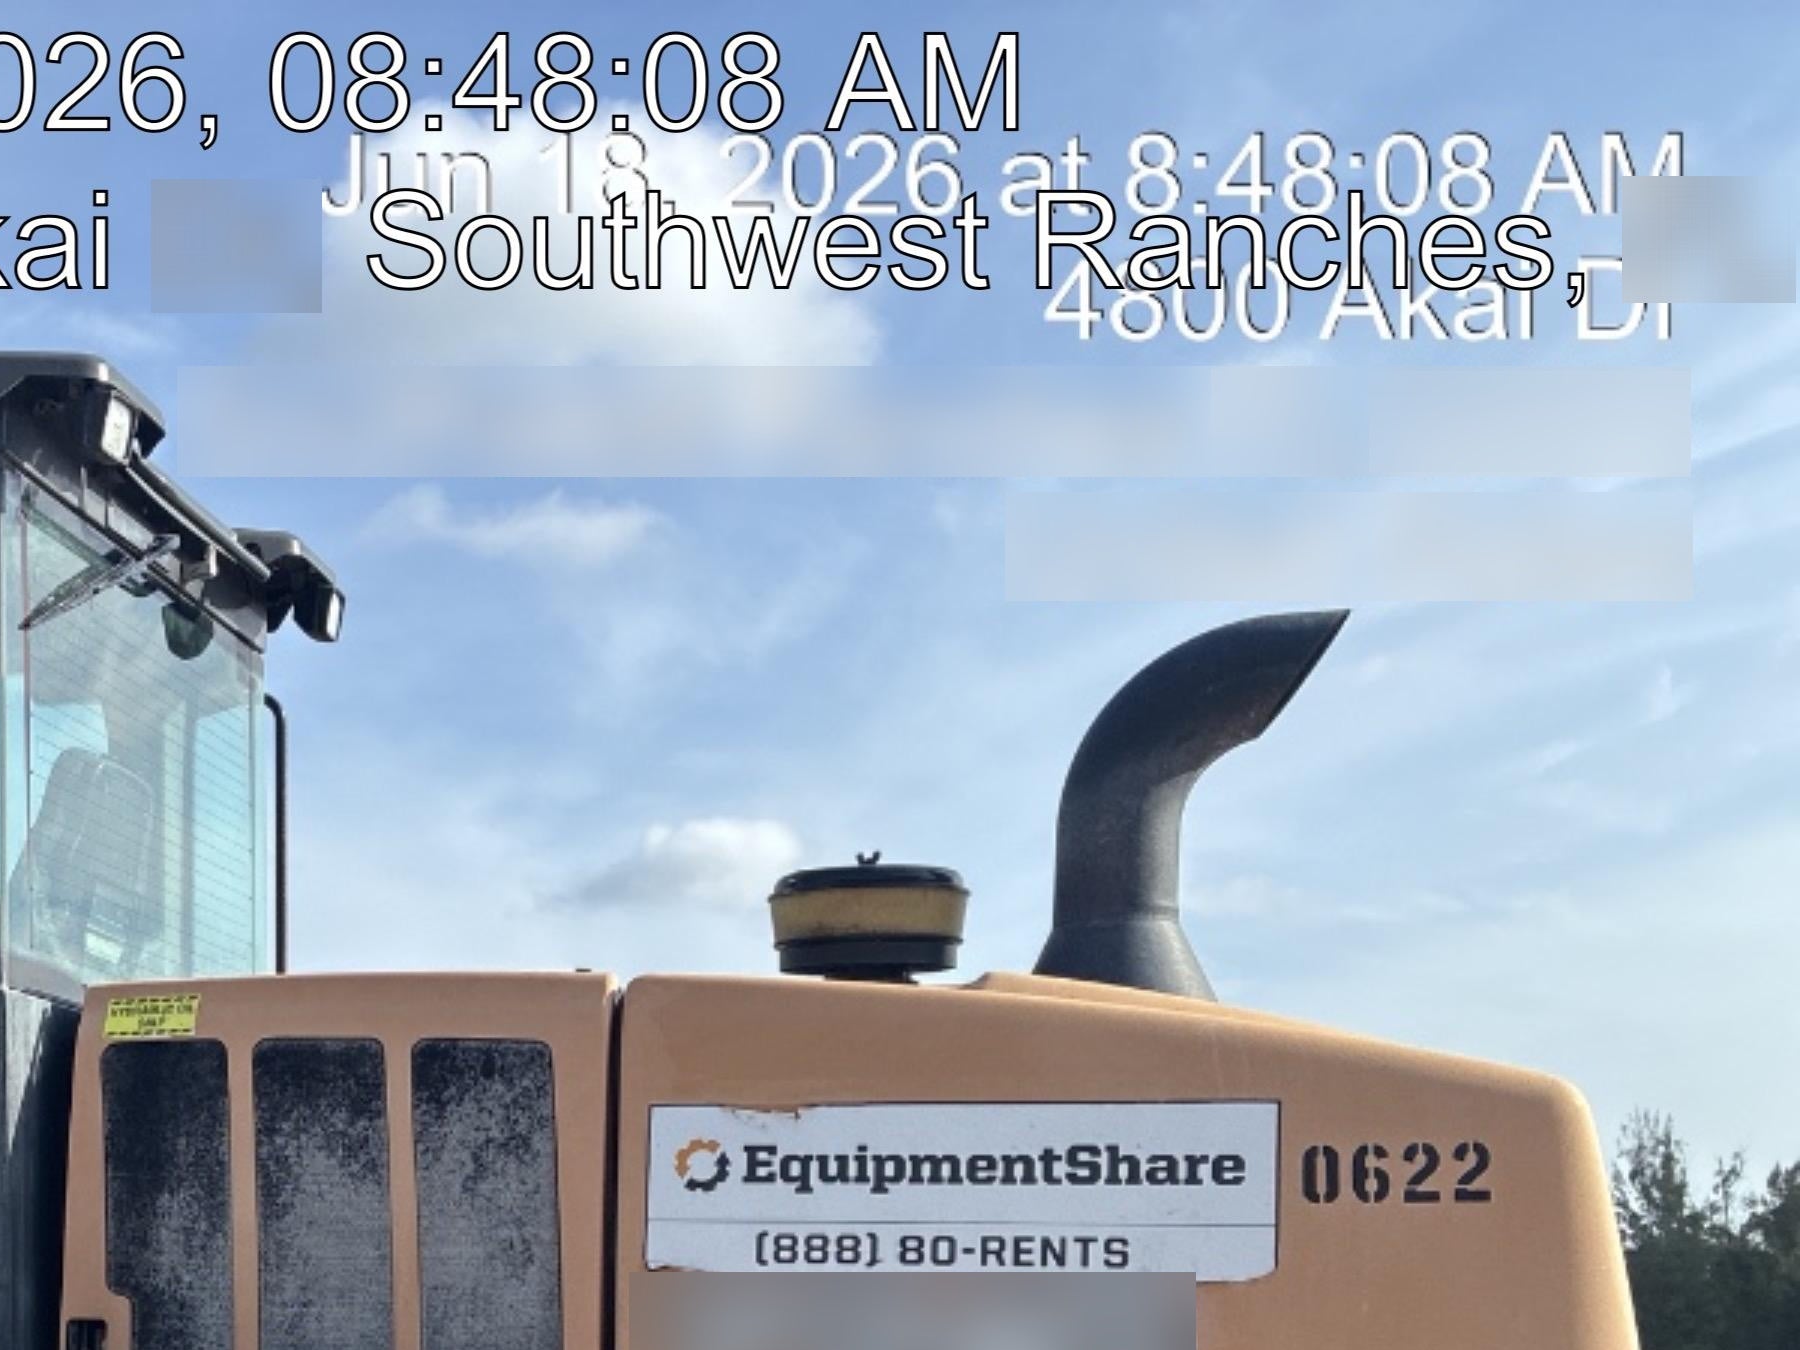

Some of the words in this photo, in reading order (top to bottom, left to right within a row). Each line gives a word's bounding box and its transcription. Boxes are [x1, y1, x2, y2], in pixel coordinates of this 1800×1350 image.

[742, 1144, 1246, 1194] EquipmentShare
[1301, 1140, 1492, 1204] 0622
[755, 1231, 880, 1267] (888)
[899, 1235, 1130, 1268] 80-RENTS
